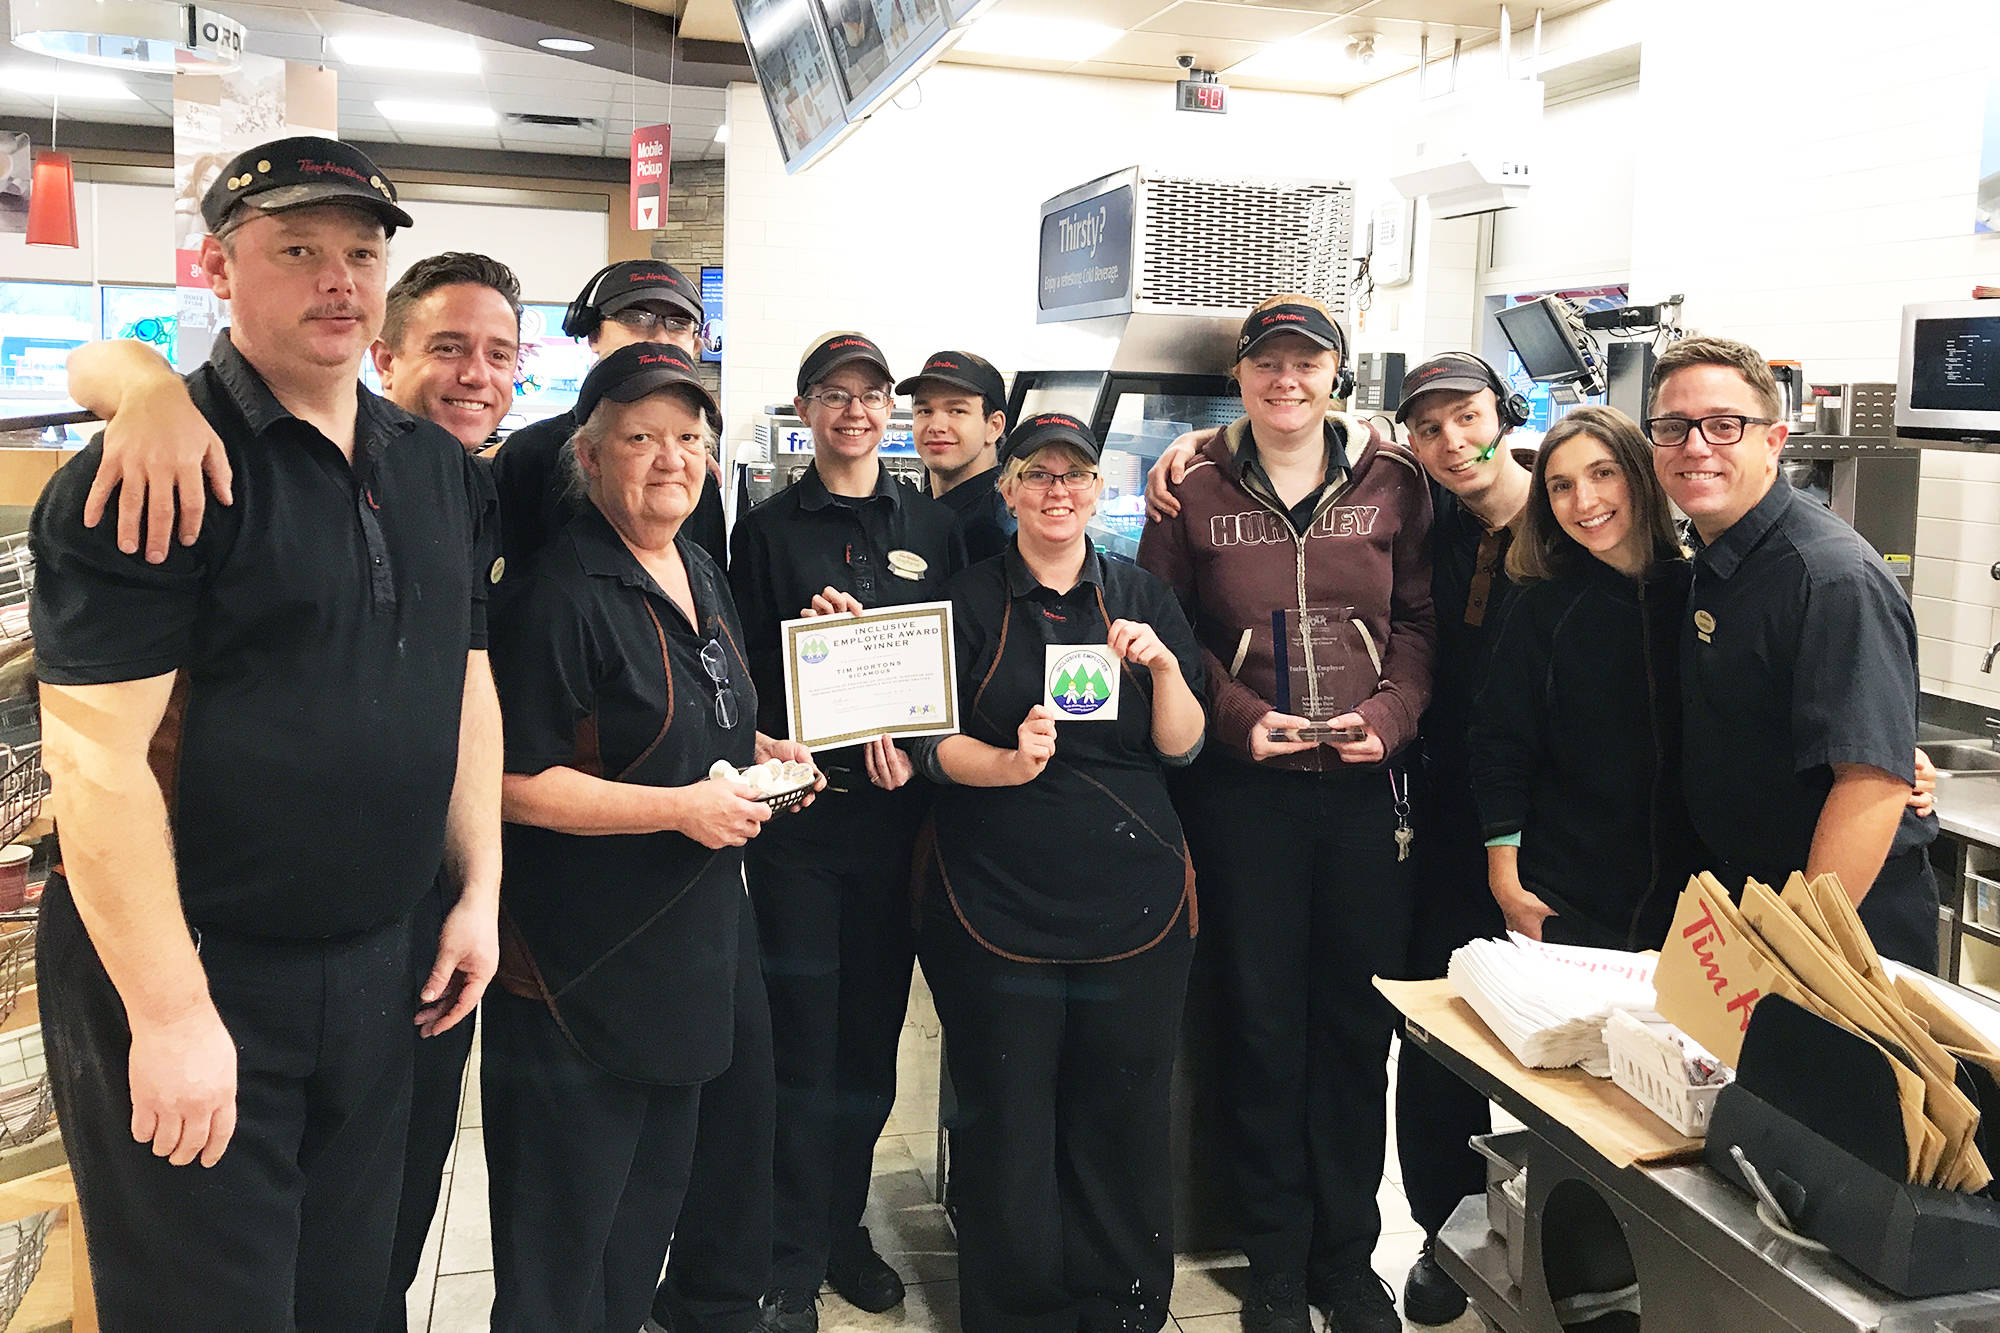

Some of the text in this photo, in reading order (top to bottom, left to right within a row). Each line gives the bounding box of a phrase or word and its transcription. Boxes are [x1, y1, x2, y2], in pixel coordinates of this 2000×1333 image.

[1197, 88, 1223, 109] 40
[637, 140, 664, 159] Mobile
[637, 160, 663, 178] Pickup
[1058, 206, 1106, 258] Thirsty?
[833, 627, 939, 647] EMPLOYER AWARD
[855, 621, 916, 635] INCLUSIVE
[863, 639, 909, 651] WINNER
[837, 660, 902, 675] TIM HORTONS
[1682, 897, 1728, 997] Tim
